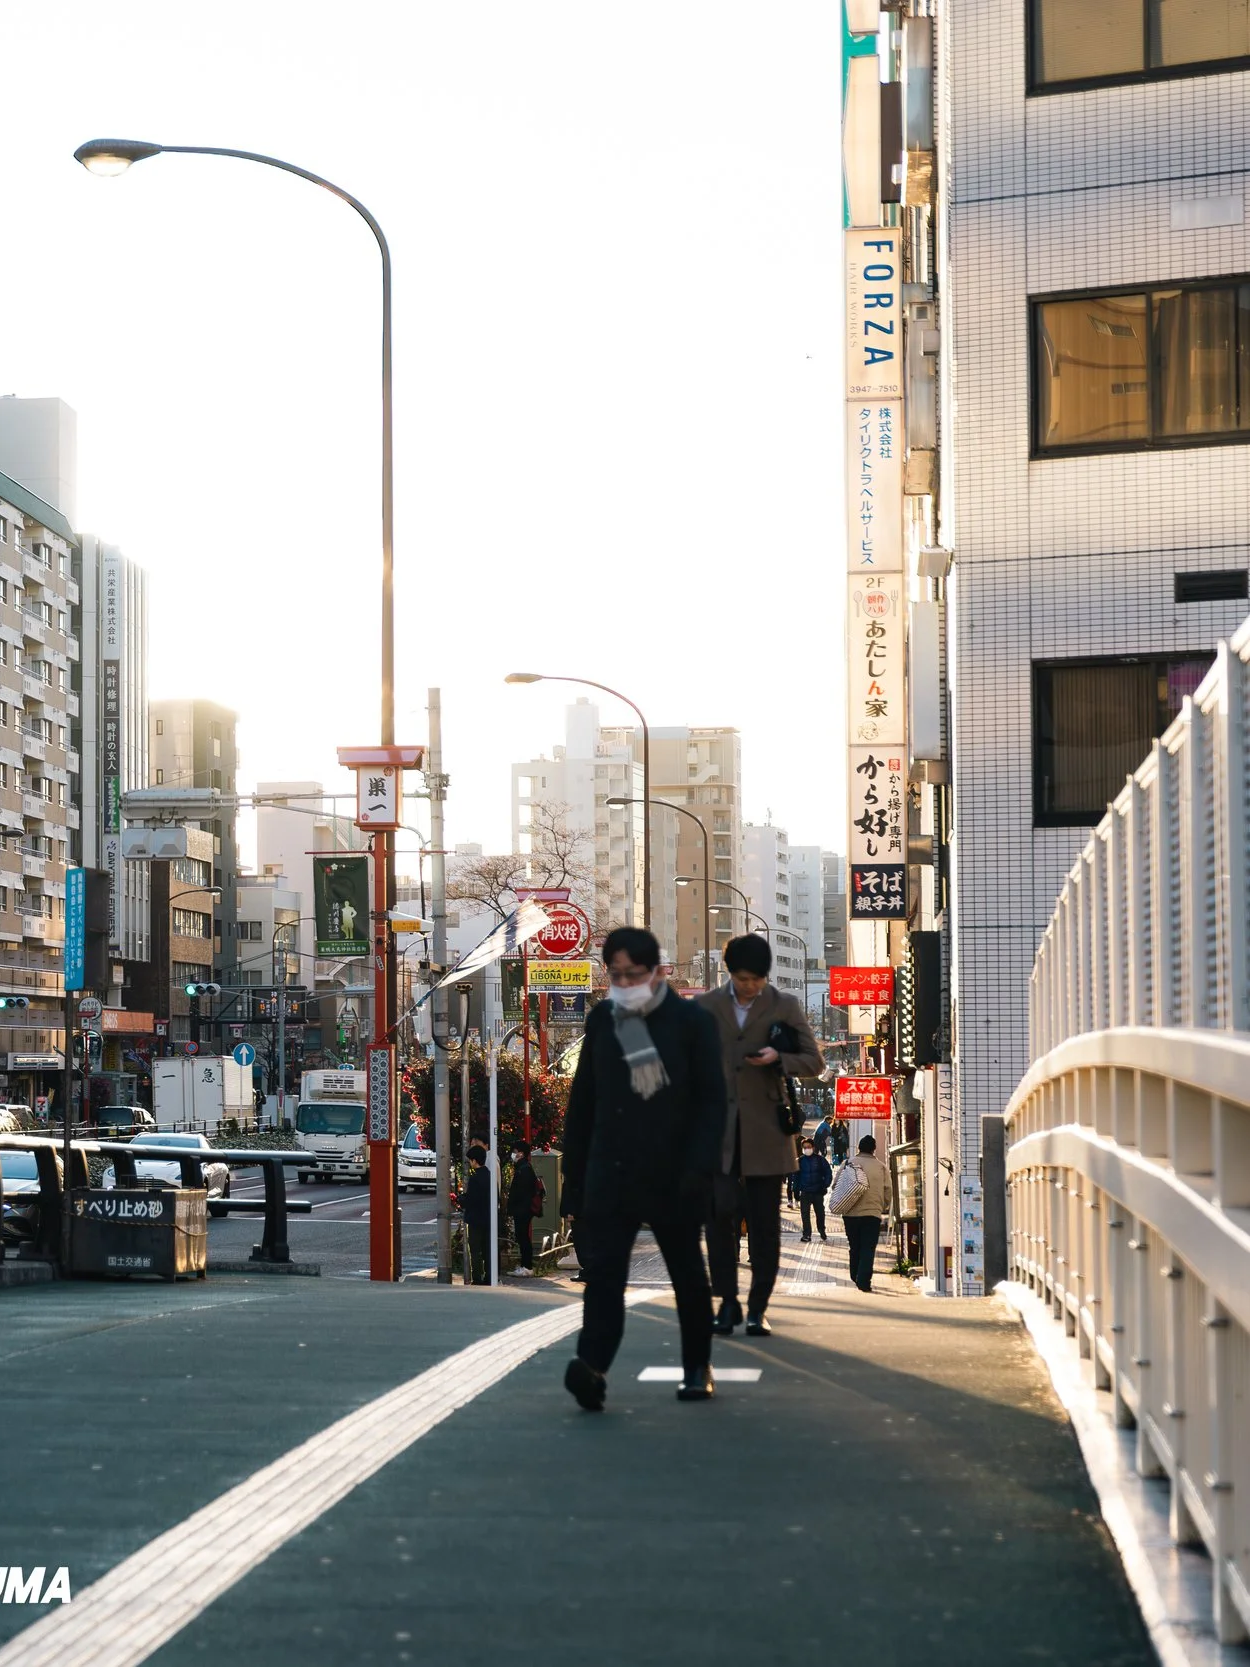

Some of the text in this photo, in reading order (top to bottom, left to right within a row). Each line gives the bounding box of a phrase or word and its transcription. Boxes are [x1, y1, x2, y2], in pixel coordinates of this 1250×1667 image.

[863, 240, 894, 366] FORZA
[850, 385, 899, 394] 3947-7510
[878, 407, 893, 459] 株式会社
[858, 407, 875, 565] タイリクトラベルサービス
[866, 577, 886, 589] 2F
[865, 619, 889, 718] あたしん家
[106, 665, 117, 712] 時計修理
[106, 721, 117, 771] 時計の玄人
[853, 754, 889, 857] から好し
[861, 871, 904, 894] そば
[854, 895, 904, 912] 親子丼
[541, 923, 579, 941] 消火栓
[530, 972, 591, 982] LIBONA リボナ
[833, 973, 891, 985] ラーメン・餃子
[833, 989, 891, 1002] 中華定食
[847, 1080, 878, 1092] スマホ
[839, 1092, 885, 1105] 相談窓口
[939, 1070, 952, 1123] FORZA
[73, 1199, 164, 1218] すべり止め砂
[107, 1256, 152, 1268] 国土交通省
